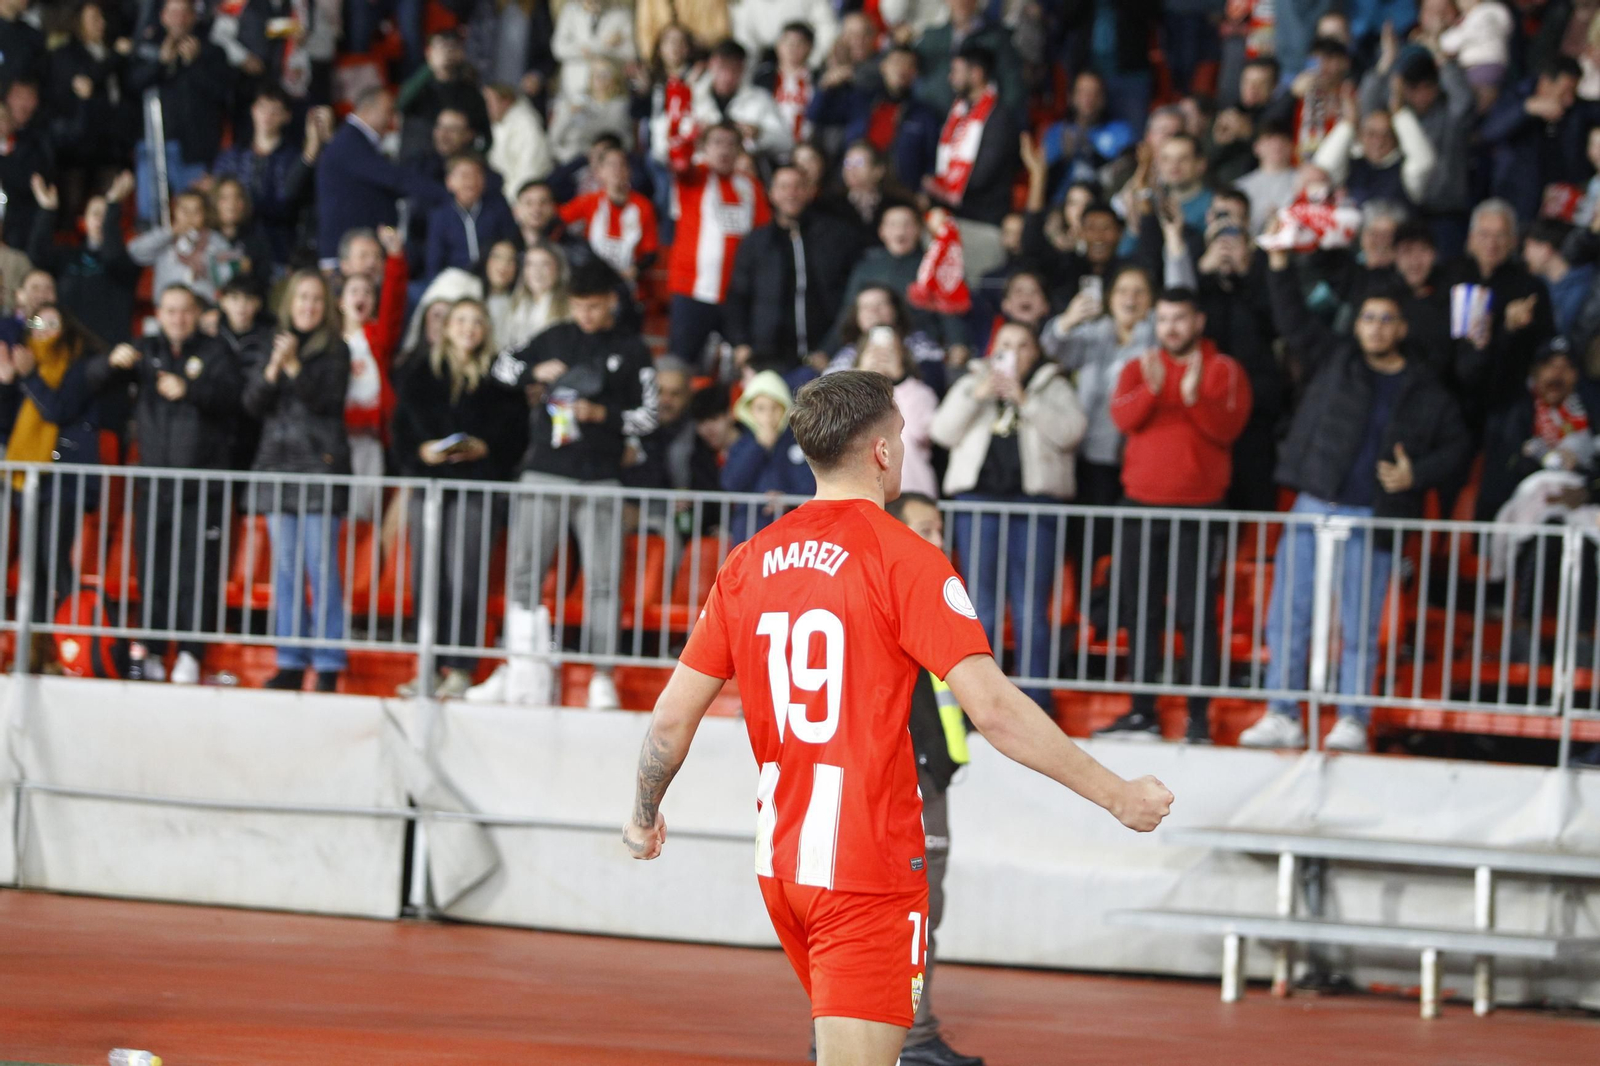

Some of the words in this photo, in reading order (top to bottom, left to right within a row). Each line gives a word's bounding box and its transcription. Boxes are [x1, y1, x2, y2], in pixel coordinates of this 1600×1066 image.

[762, 540, 850, 578] MAREZI
[755, 608, 845, 744] 19
[907, 911, 929, 966] 1
